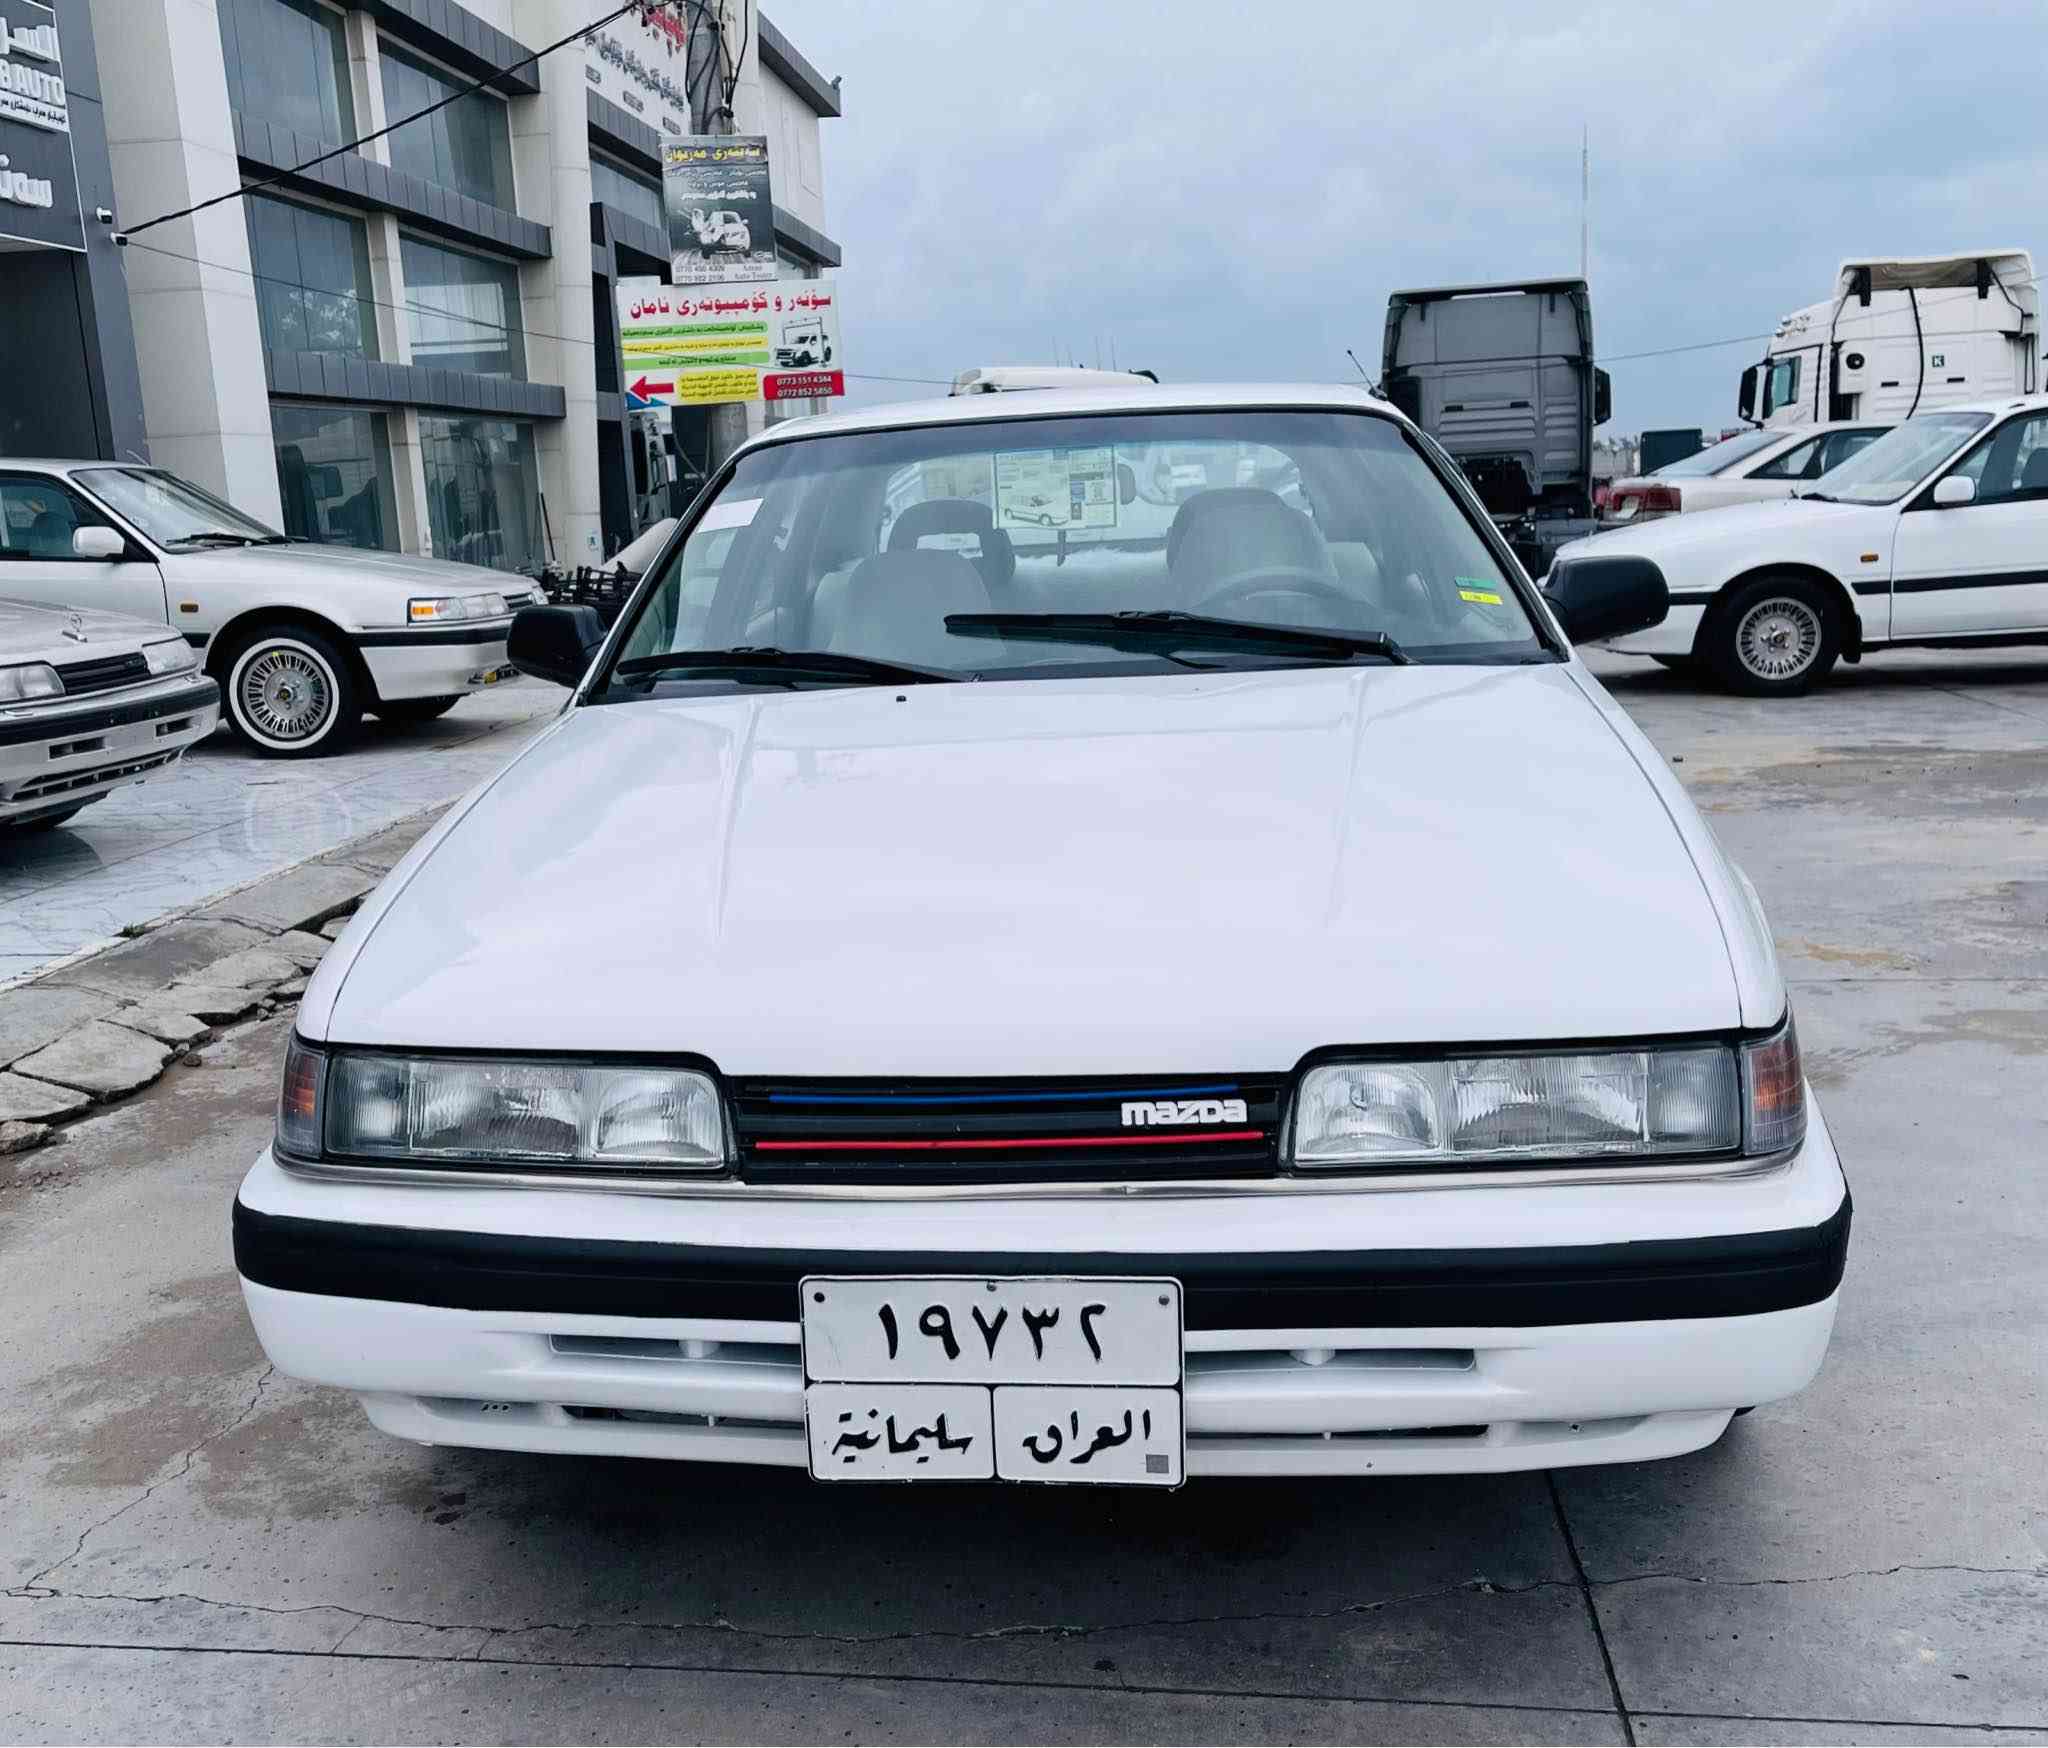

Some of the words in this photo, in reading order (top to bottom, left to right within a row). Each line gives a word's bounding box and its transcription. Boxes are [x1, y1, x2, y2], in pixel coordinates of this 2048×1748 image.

[773, 296, 783, 312] و
[877, 1303, 1107, 1363] ١٩٧٣٢
[831, 1408, 974, 1464] سليمانية
[1022, 1409, 1151, 1464] العراق
